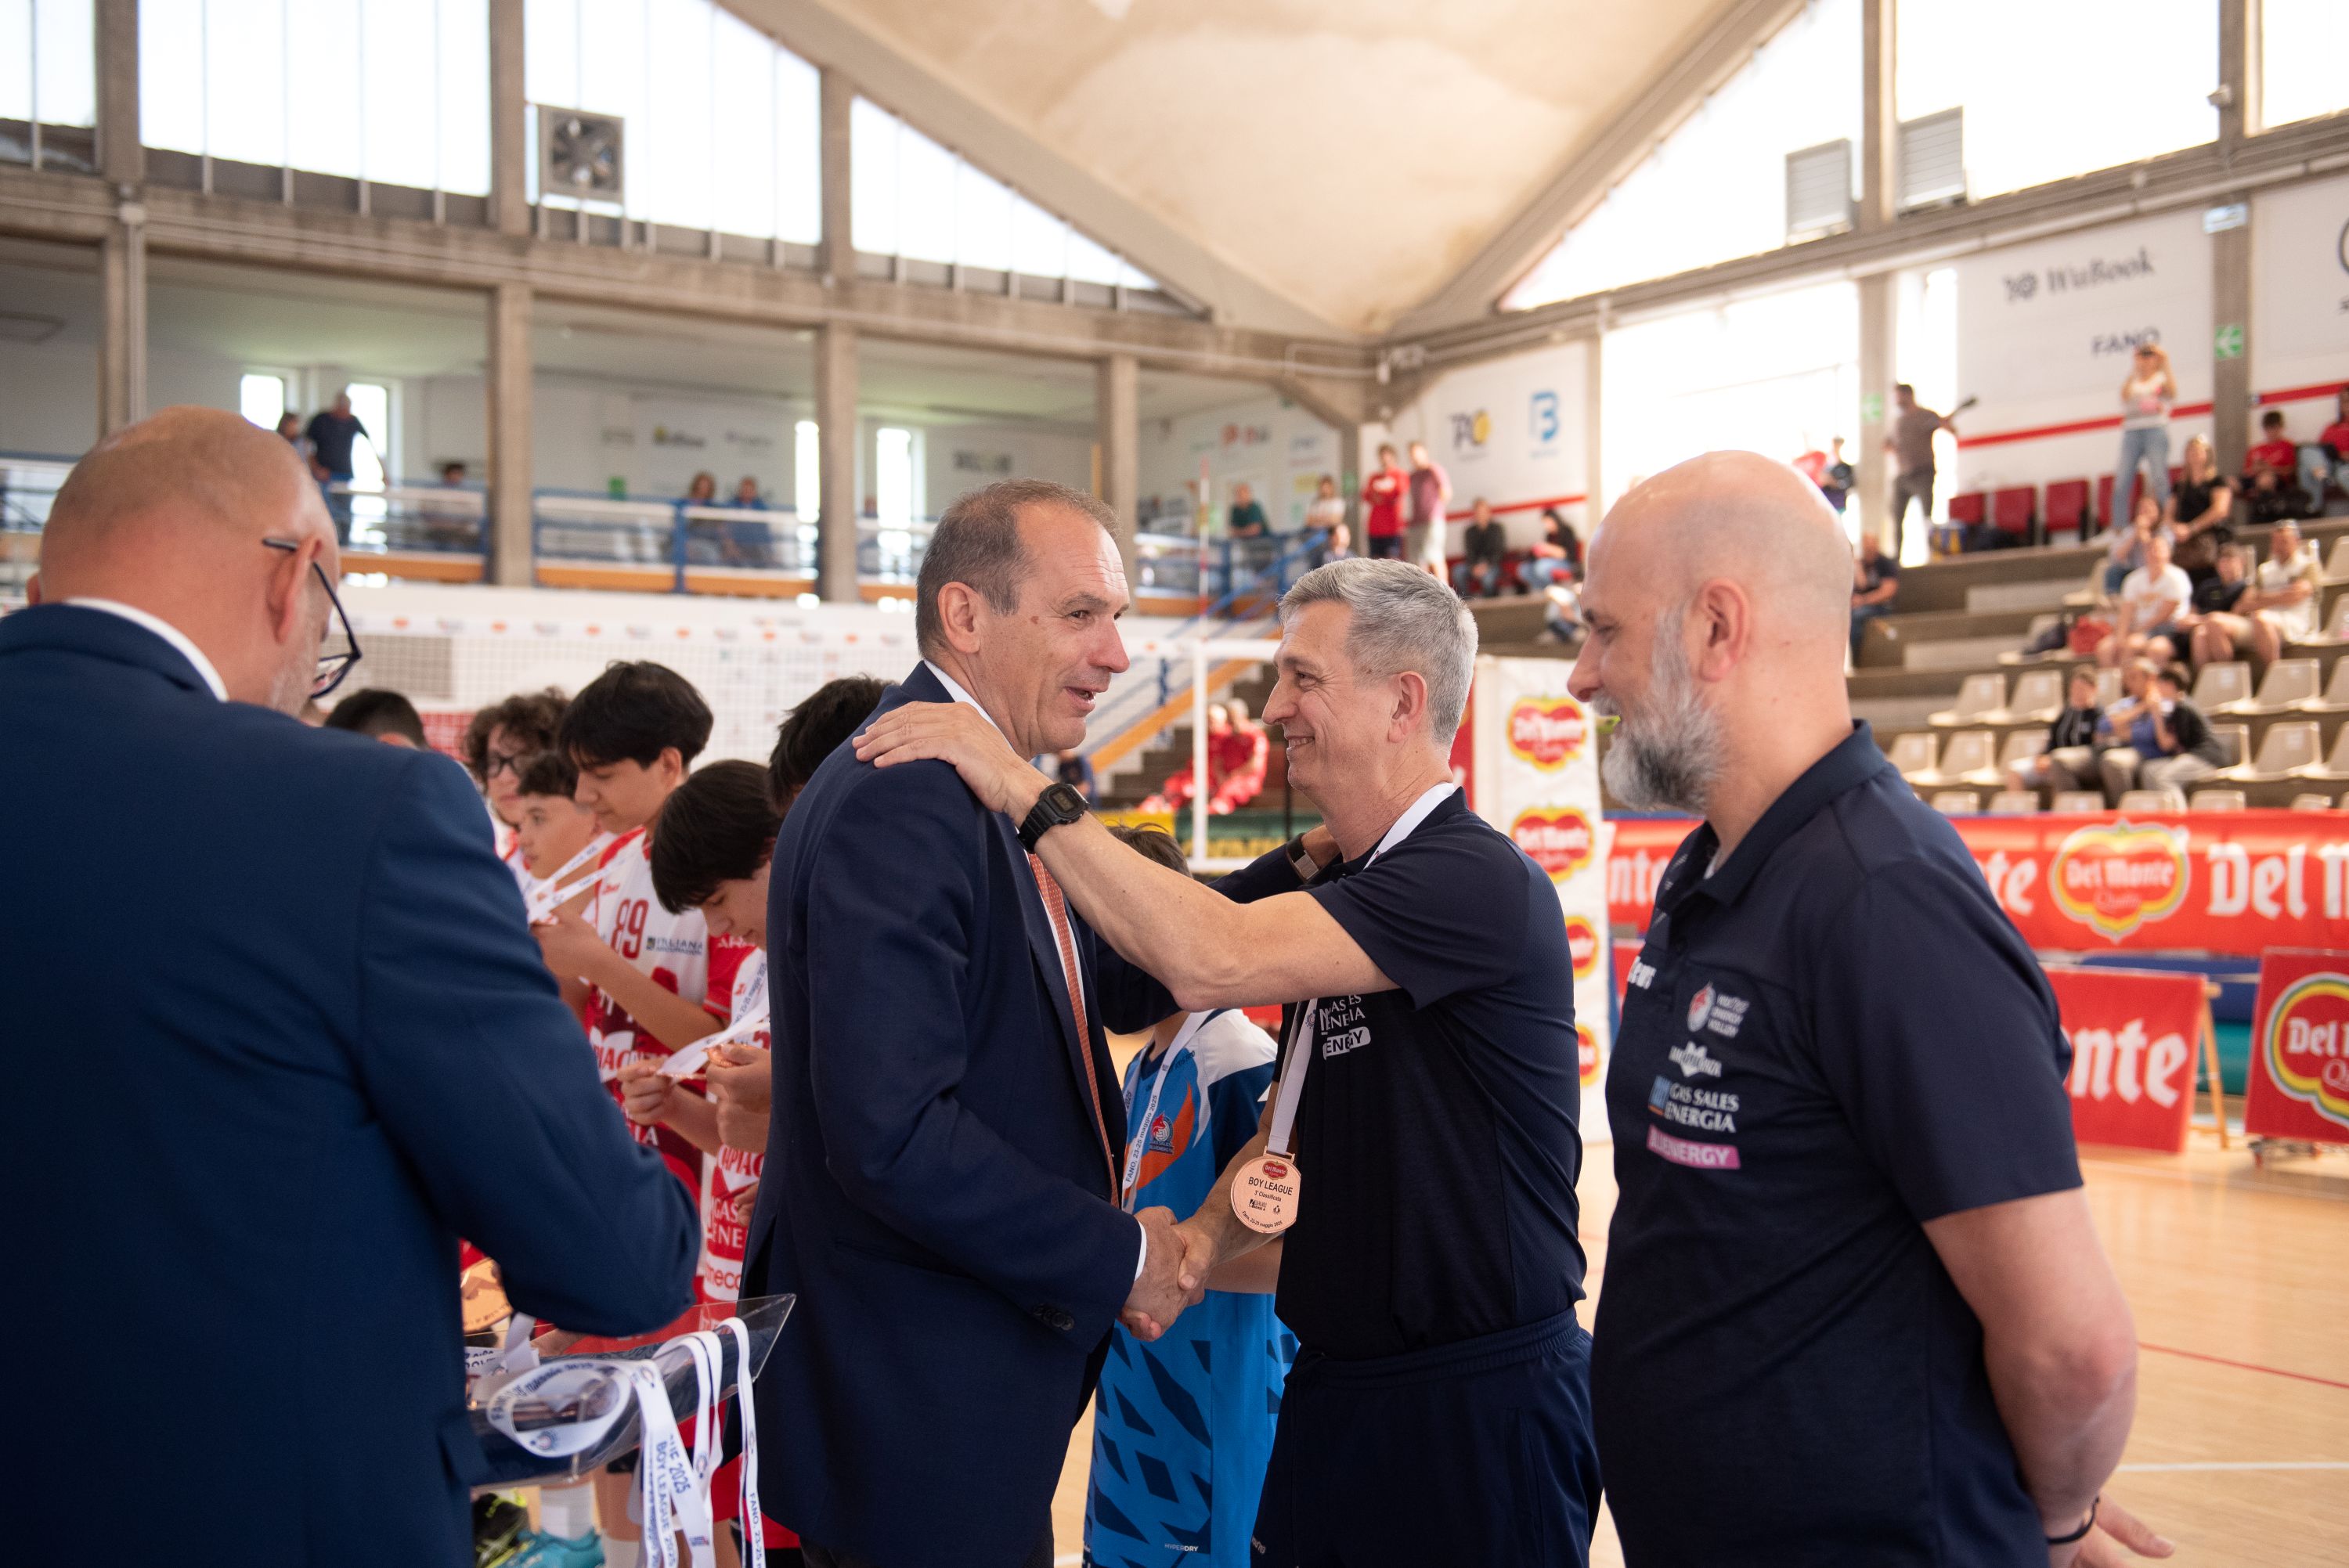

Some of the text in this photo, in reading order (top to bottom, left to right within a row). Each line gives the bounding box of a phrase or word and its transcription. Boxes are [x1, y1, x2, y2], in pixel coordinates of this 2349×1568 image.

[2067, 858, 2175, 889] Del Monte
[2207, 842, 2307, 920] Del
[2286, 1017, 2338, 1057] Del
[1692, 1089, 1740, 1113] SALES
[1664, 1101, 1737, 1134] ENERGIA
[1132, 1138, 1143, 1159] 23-25
[1140, 1112, 1153, 1139] maggio
[1248, 1177, 1294, 1195] BOY LEAGUE
[1258, 1191, 1282, 1202] Classificata
[656, 1440, 667, 1470] BOY
[669, 1463, 691, 1494] 2025
[657, 1475, 670, 1529] LEAGUE
[749, 1492, 760, 1528] FANO,
